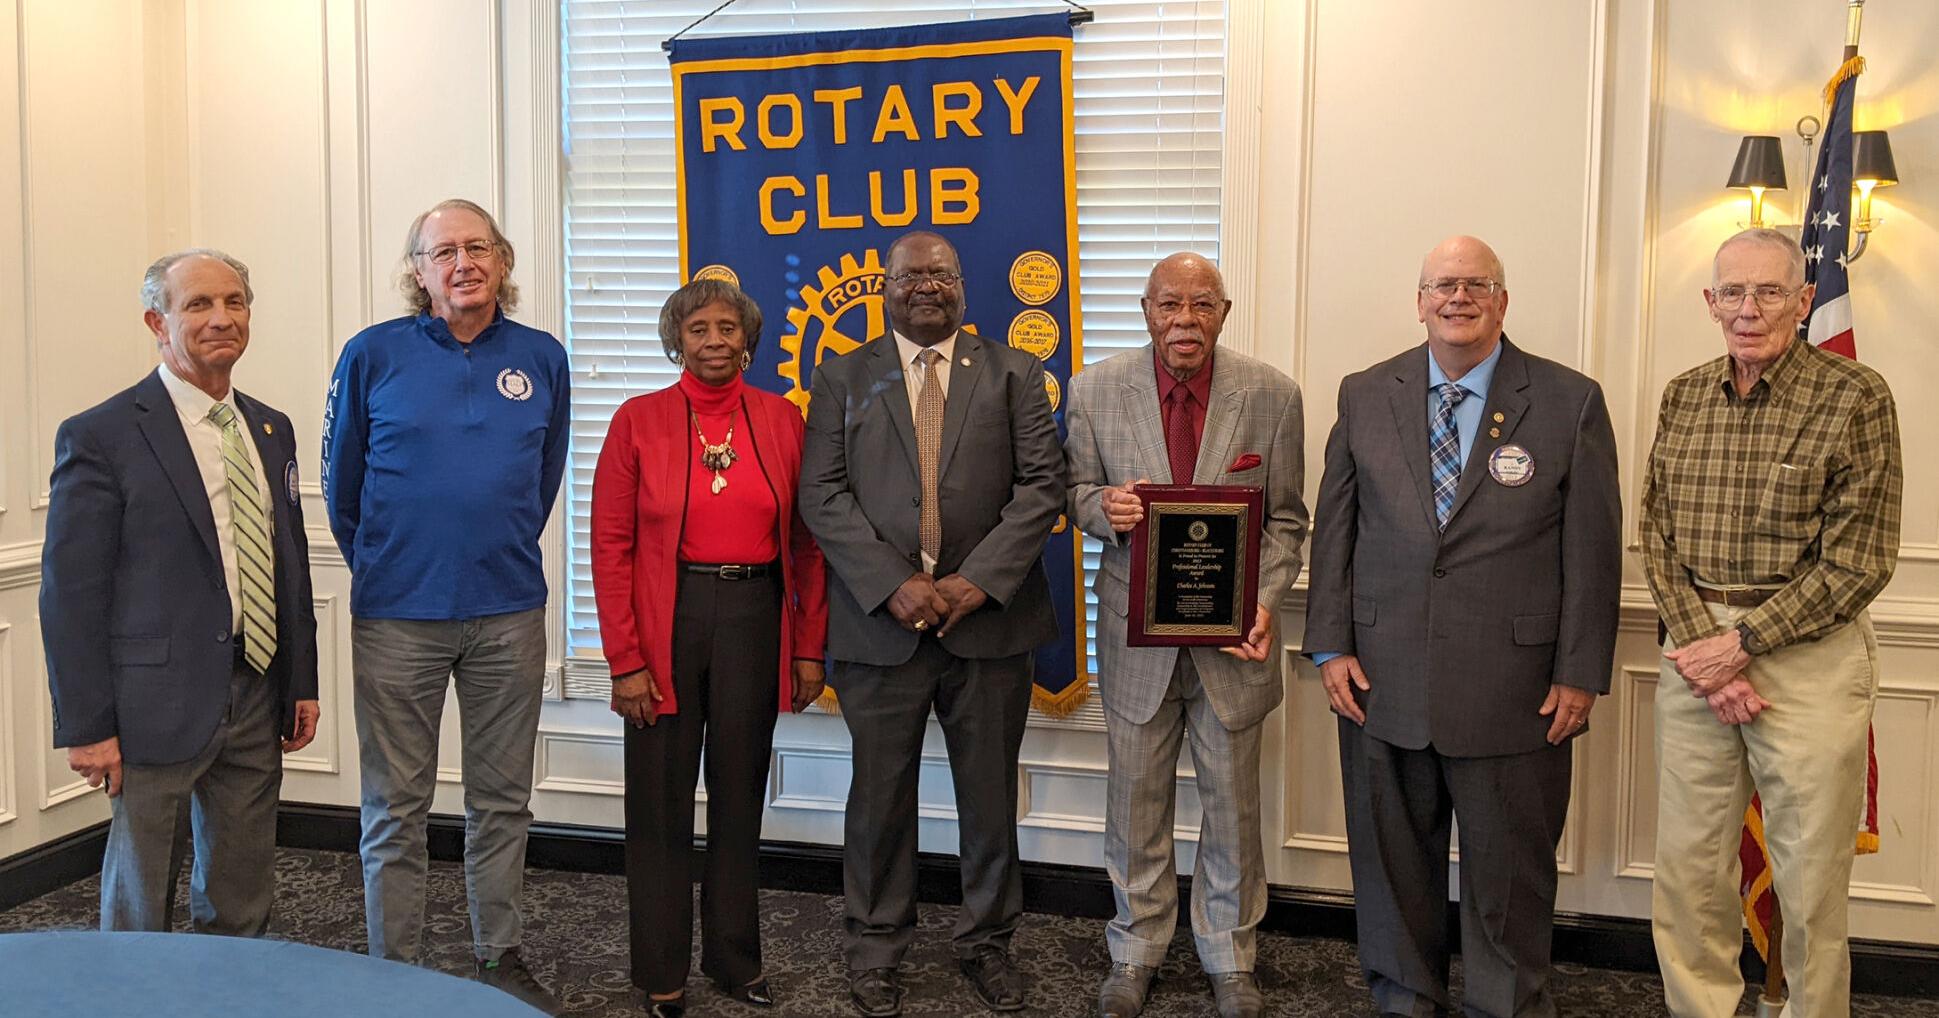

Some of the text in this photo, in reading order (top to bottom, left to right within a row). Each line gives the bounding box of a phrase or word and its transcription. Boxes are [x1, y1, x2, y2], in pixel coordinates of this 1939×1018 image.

[699, 76, 1040, 153] ROTARY
[759, 167, 980, 235] CLUB
[828, 275, 884, 309] ROTA
[321, 379, 340, 509] MARINE
